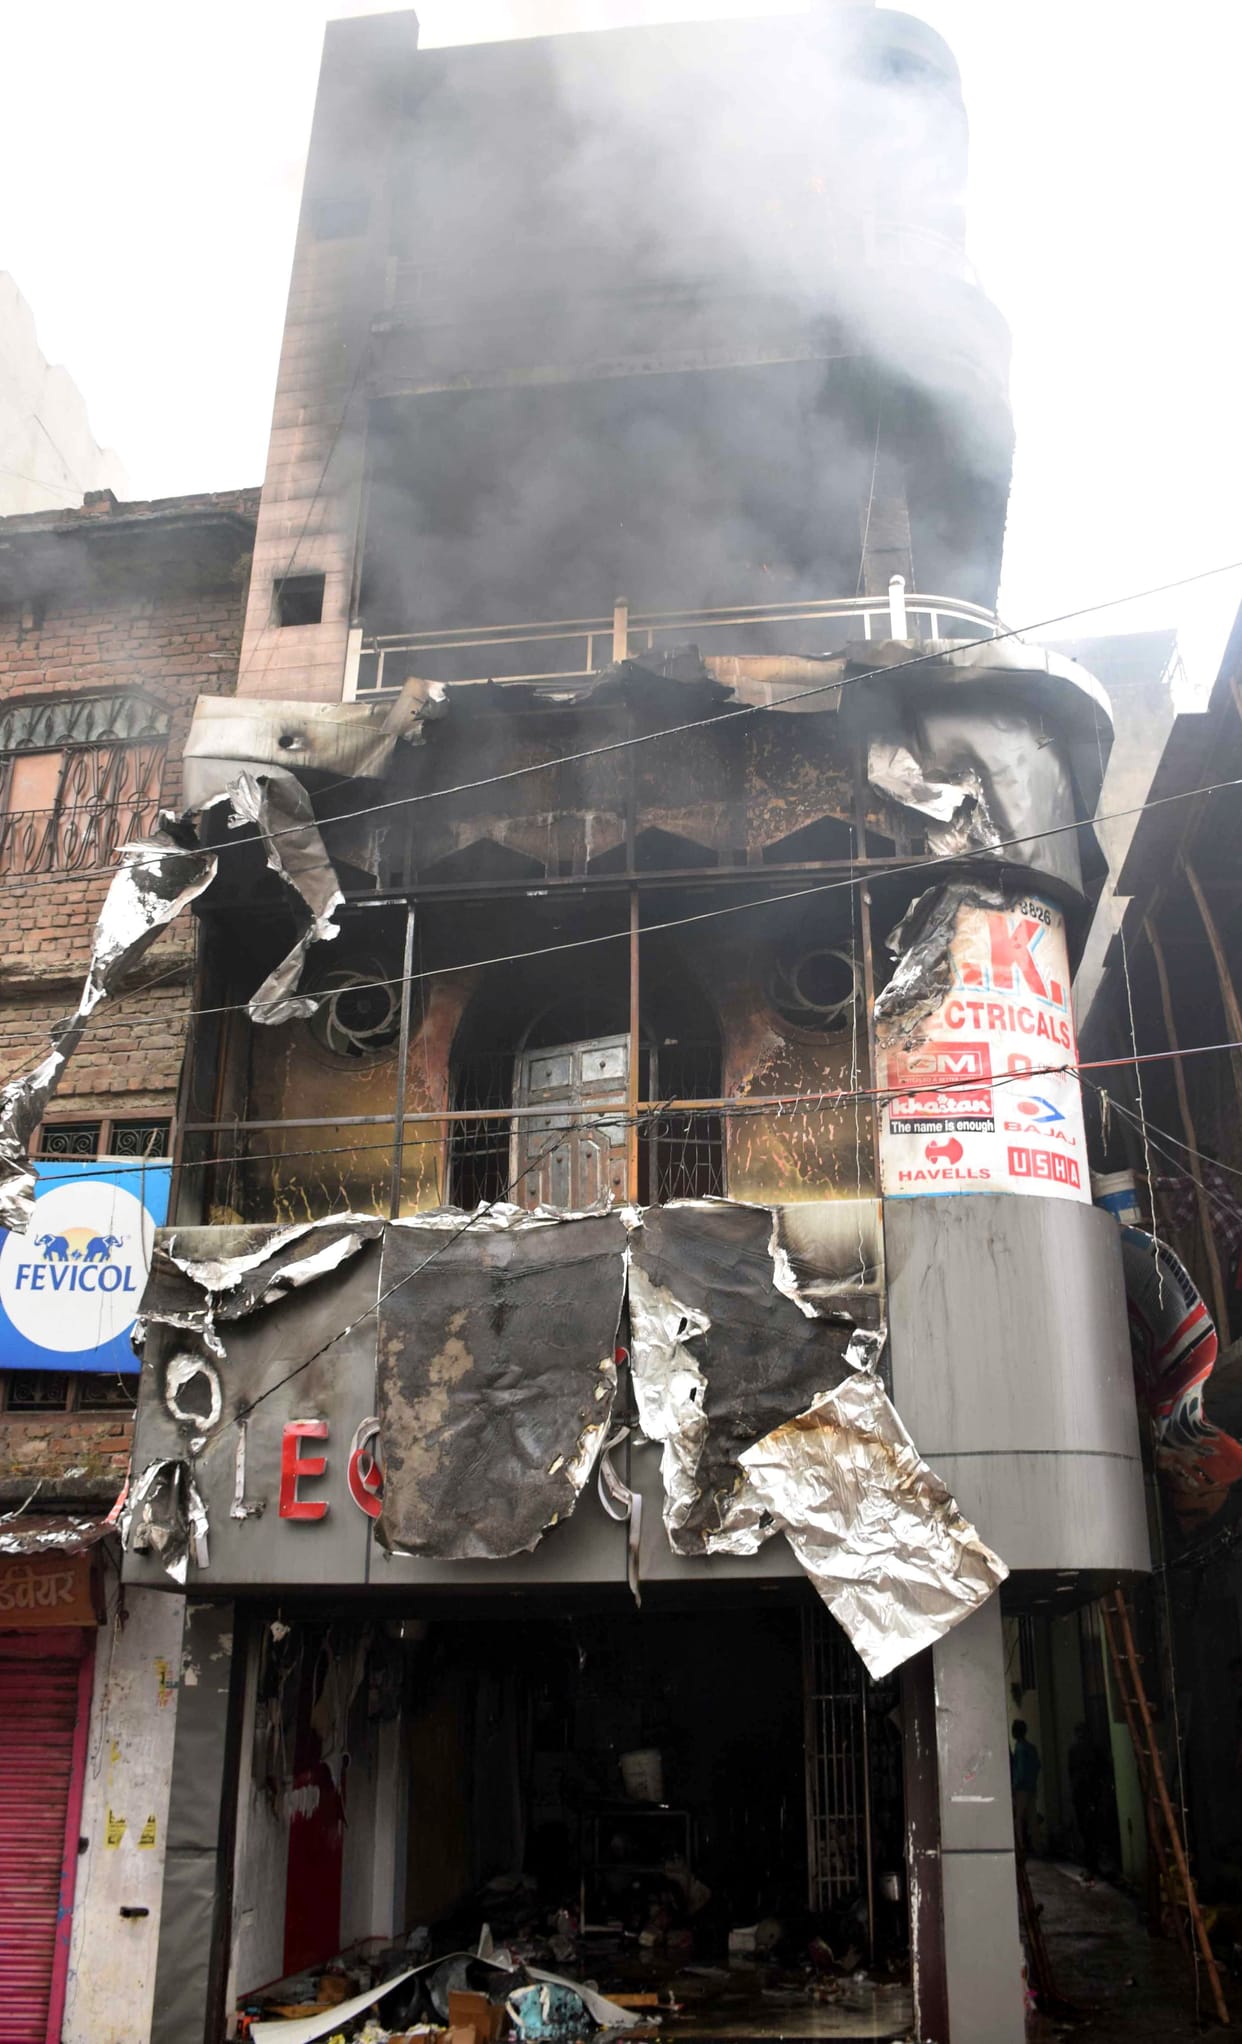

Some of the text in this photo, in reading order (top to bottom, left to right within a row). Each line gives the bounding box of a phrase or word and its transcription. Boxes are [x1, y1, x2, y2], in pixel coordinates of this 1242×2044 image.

[907, 1054, 977, 1074] GM
[891, 1119, 994, 1133] The name is enough
[1004, 1121, 1076, 1146] BAJAJ
[899, 1168, 991, 1182] HAVELLS
[1009, 1147, 1080, 1188] USHA
[15, 1263, 137, 1292] FEVICOL
